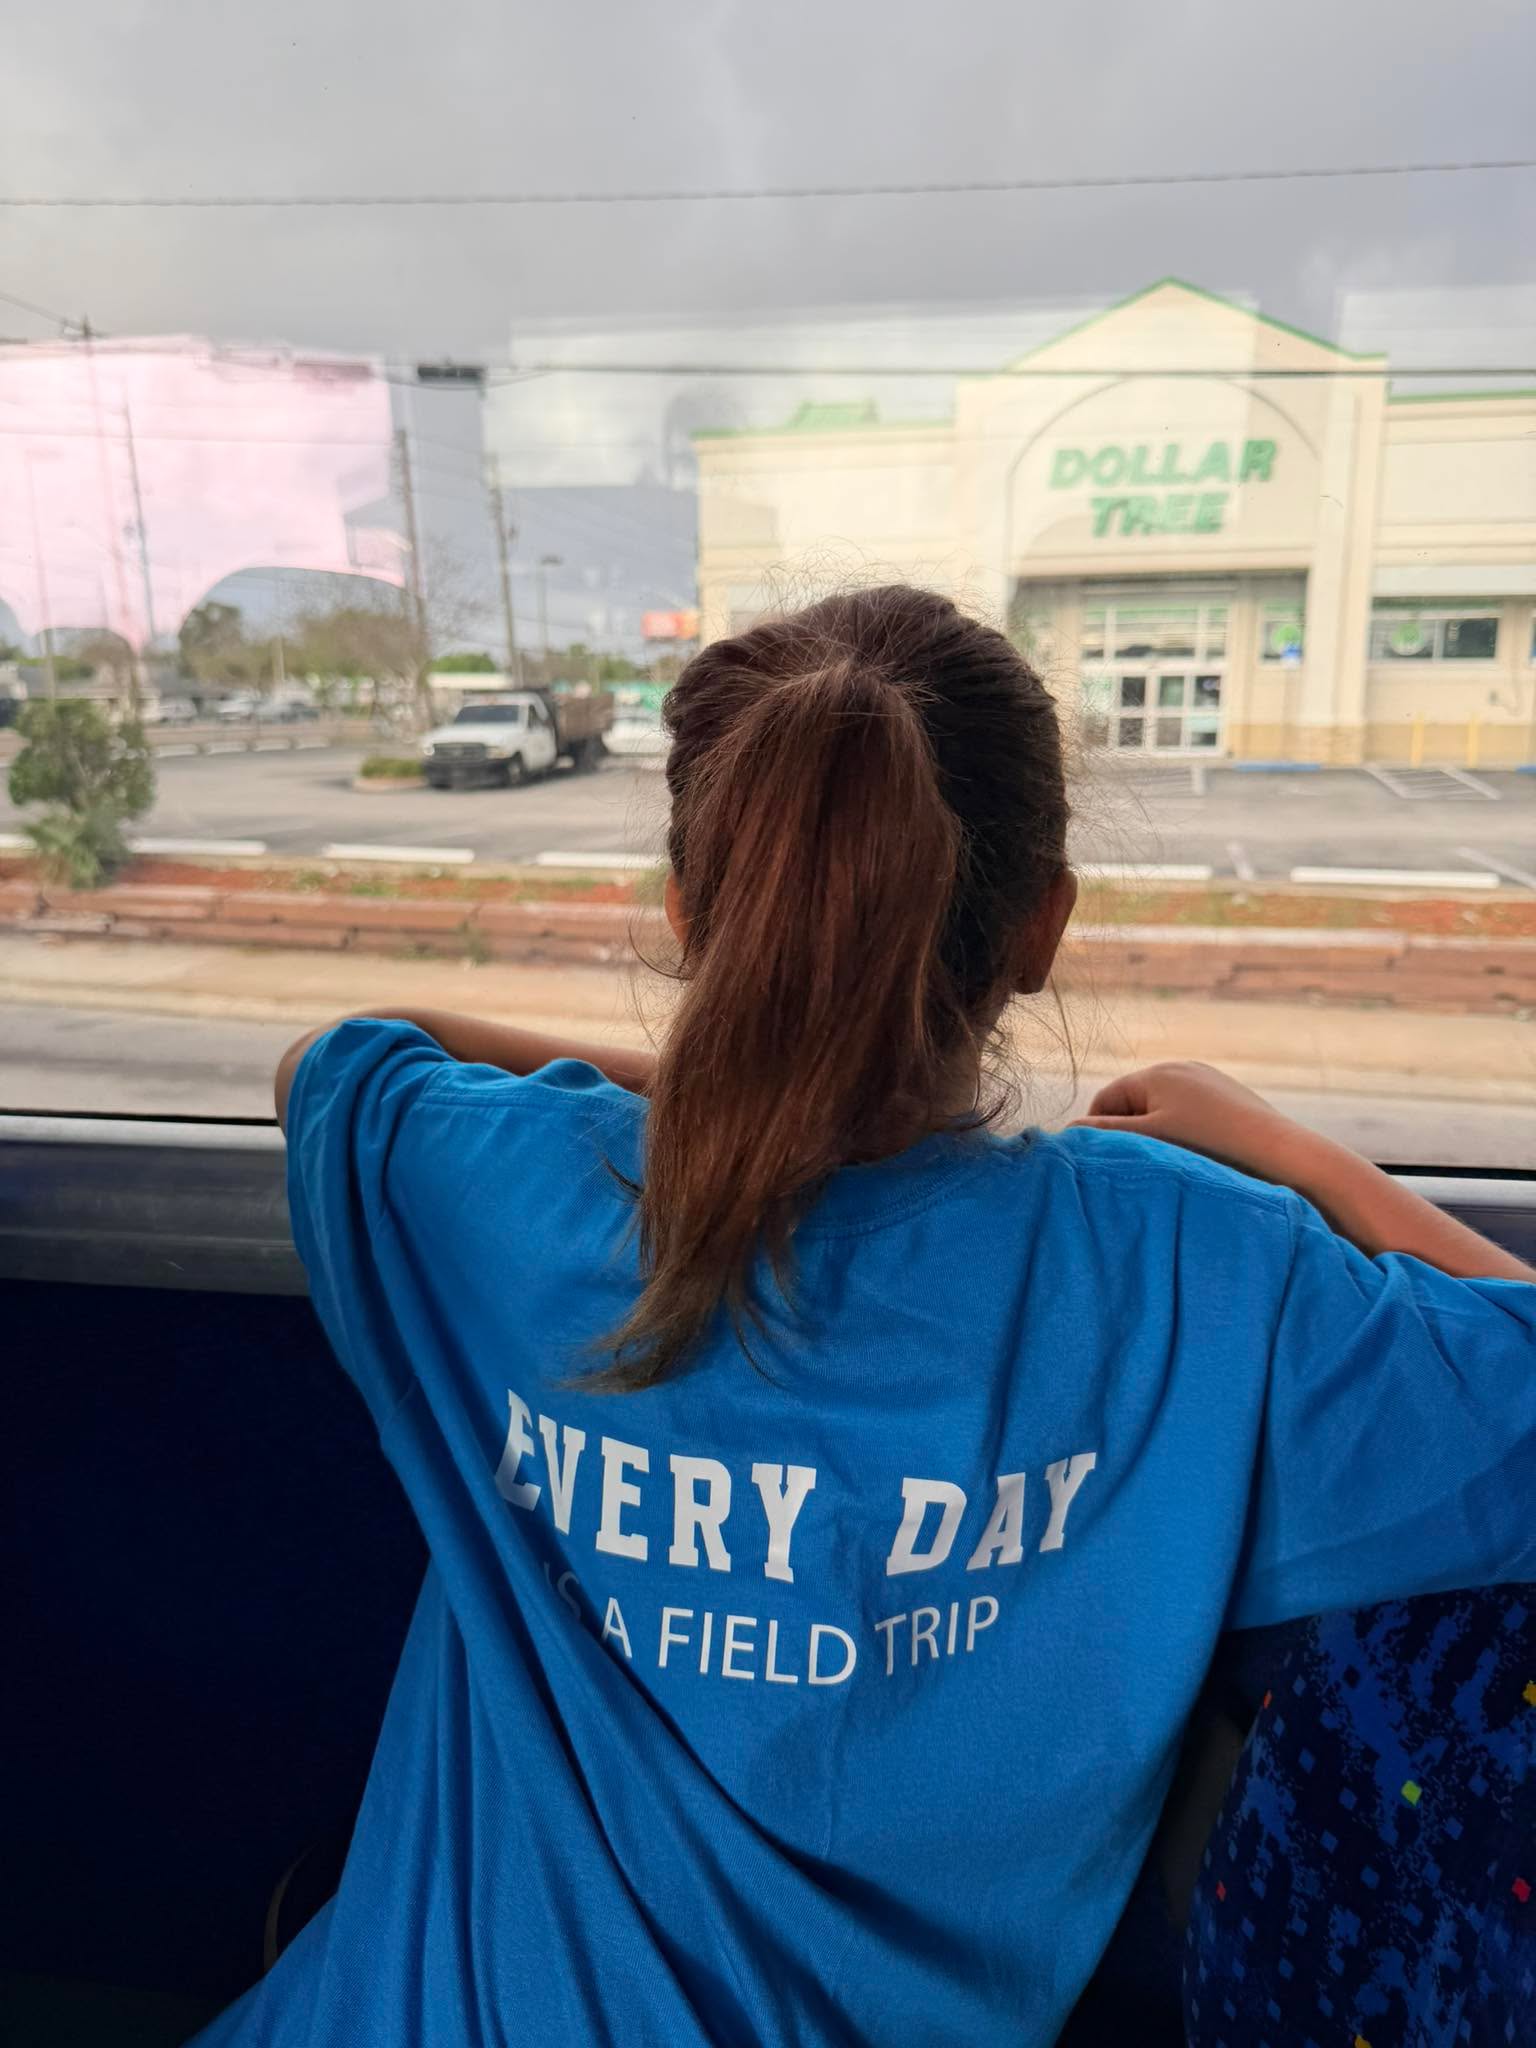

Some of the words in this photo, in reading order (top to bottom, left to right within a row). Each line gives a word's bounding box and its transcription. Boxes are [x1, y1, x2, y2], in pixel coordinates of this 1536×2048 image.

[1050, 439, 1277, 488] DOLLAR
[1091, 492, 1229, 538] TREE
[496, 1389, 816, 1583] EVERY
[887, 1452, 1096, 1575] DAY
[602, 1596, 632, 1659] A
[658, 1607, 856, 1684] FIELD
[875, 1595, 1000, 1675] TRIP
